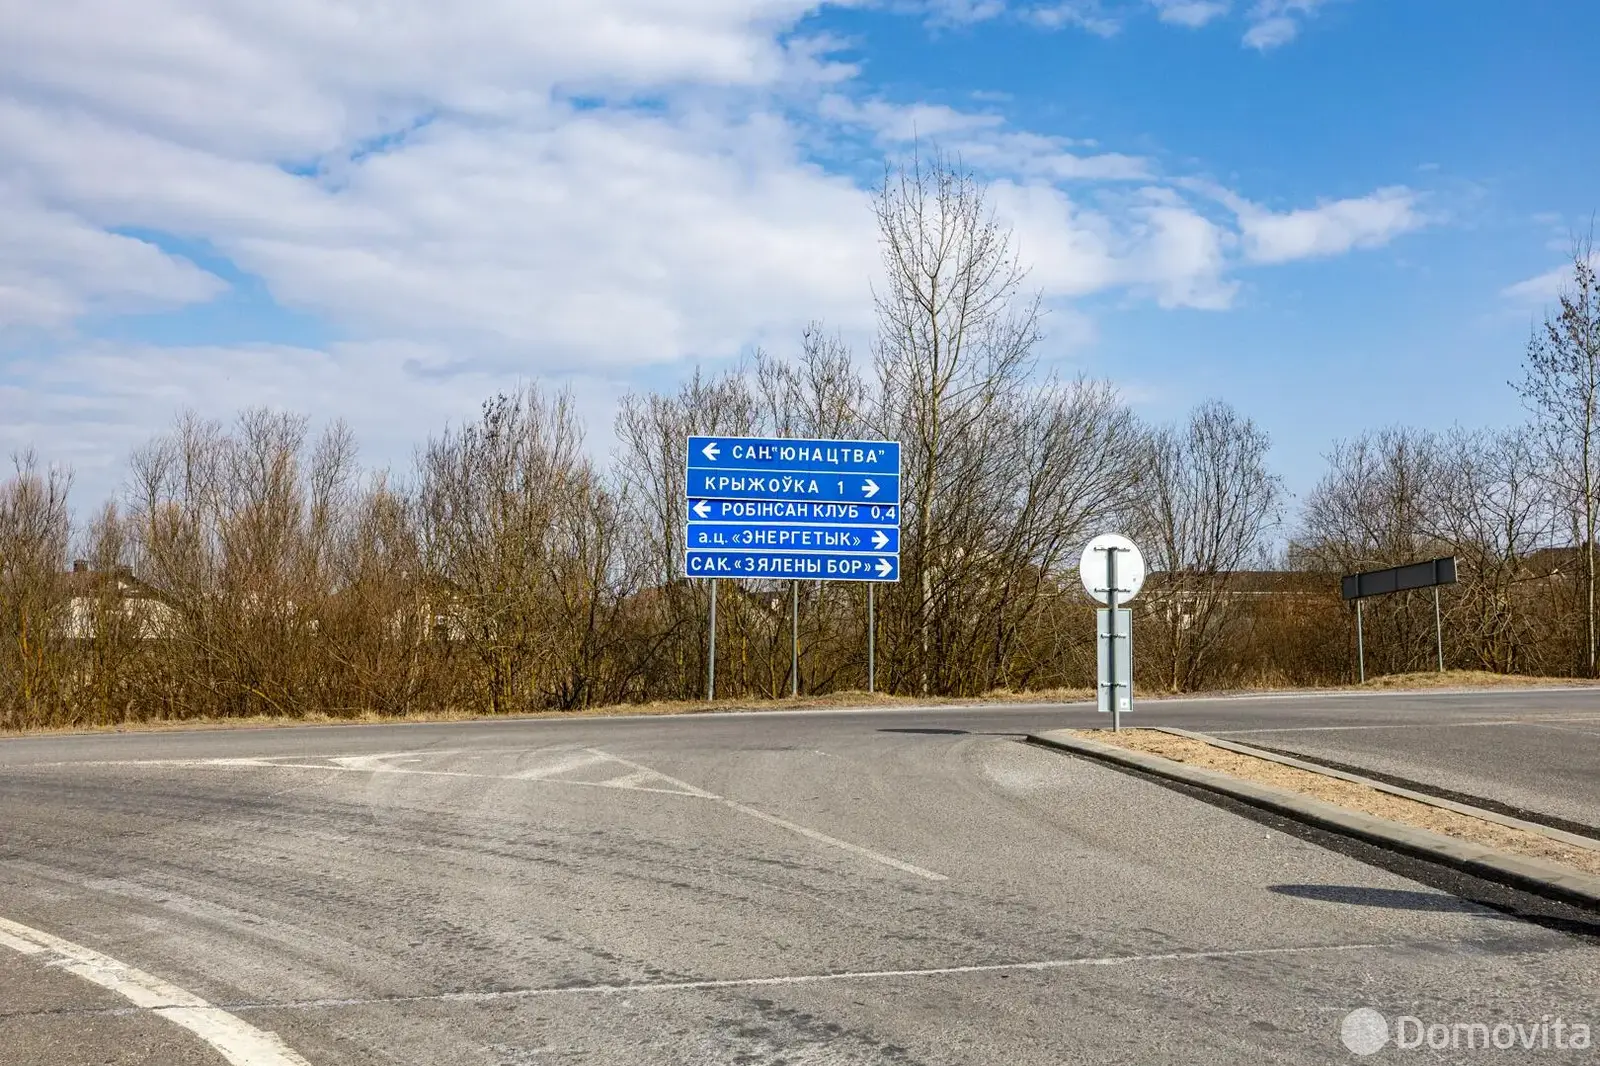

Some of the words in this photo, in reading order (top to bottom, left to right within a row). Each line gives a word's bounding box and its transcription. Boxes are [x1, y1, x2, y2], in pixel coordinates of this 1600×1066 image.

[704, 476, 819, 494] КРЫЖОЎКА
[837, 481, 844, 495] 1
[721, 502, 808, 517] РОБІНСАН
[813, 504, 859, 518] КЛУБ
[871, 505, 896, 520] 0,4
[698, 531, 728, 545] а.ц.
[732, 530, 861, 546] «ЭНЕРГЕТЫК»
[690, 556, 732, 571] САК.
[734, 557, 821, 573] «ЗЯЛЕНЫ
[827, 559, 871, 574] БОР»
